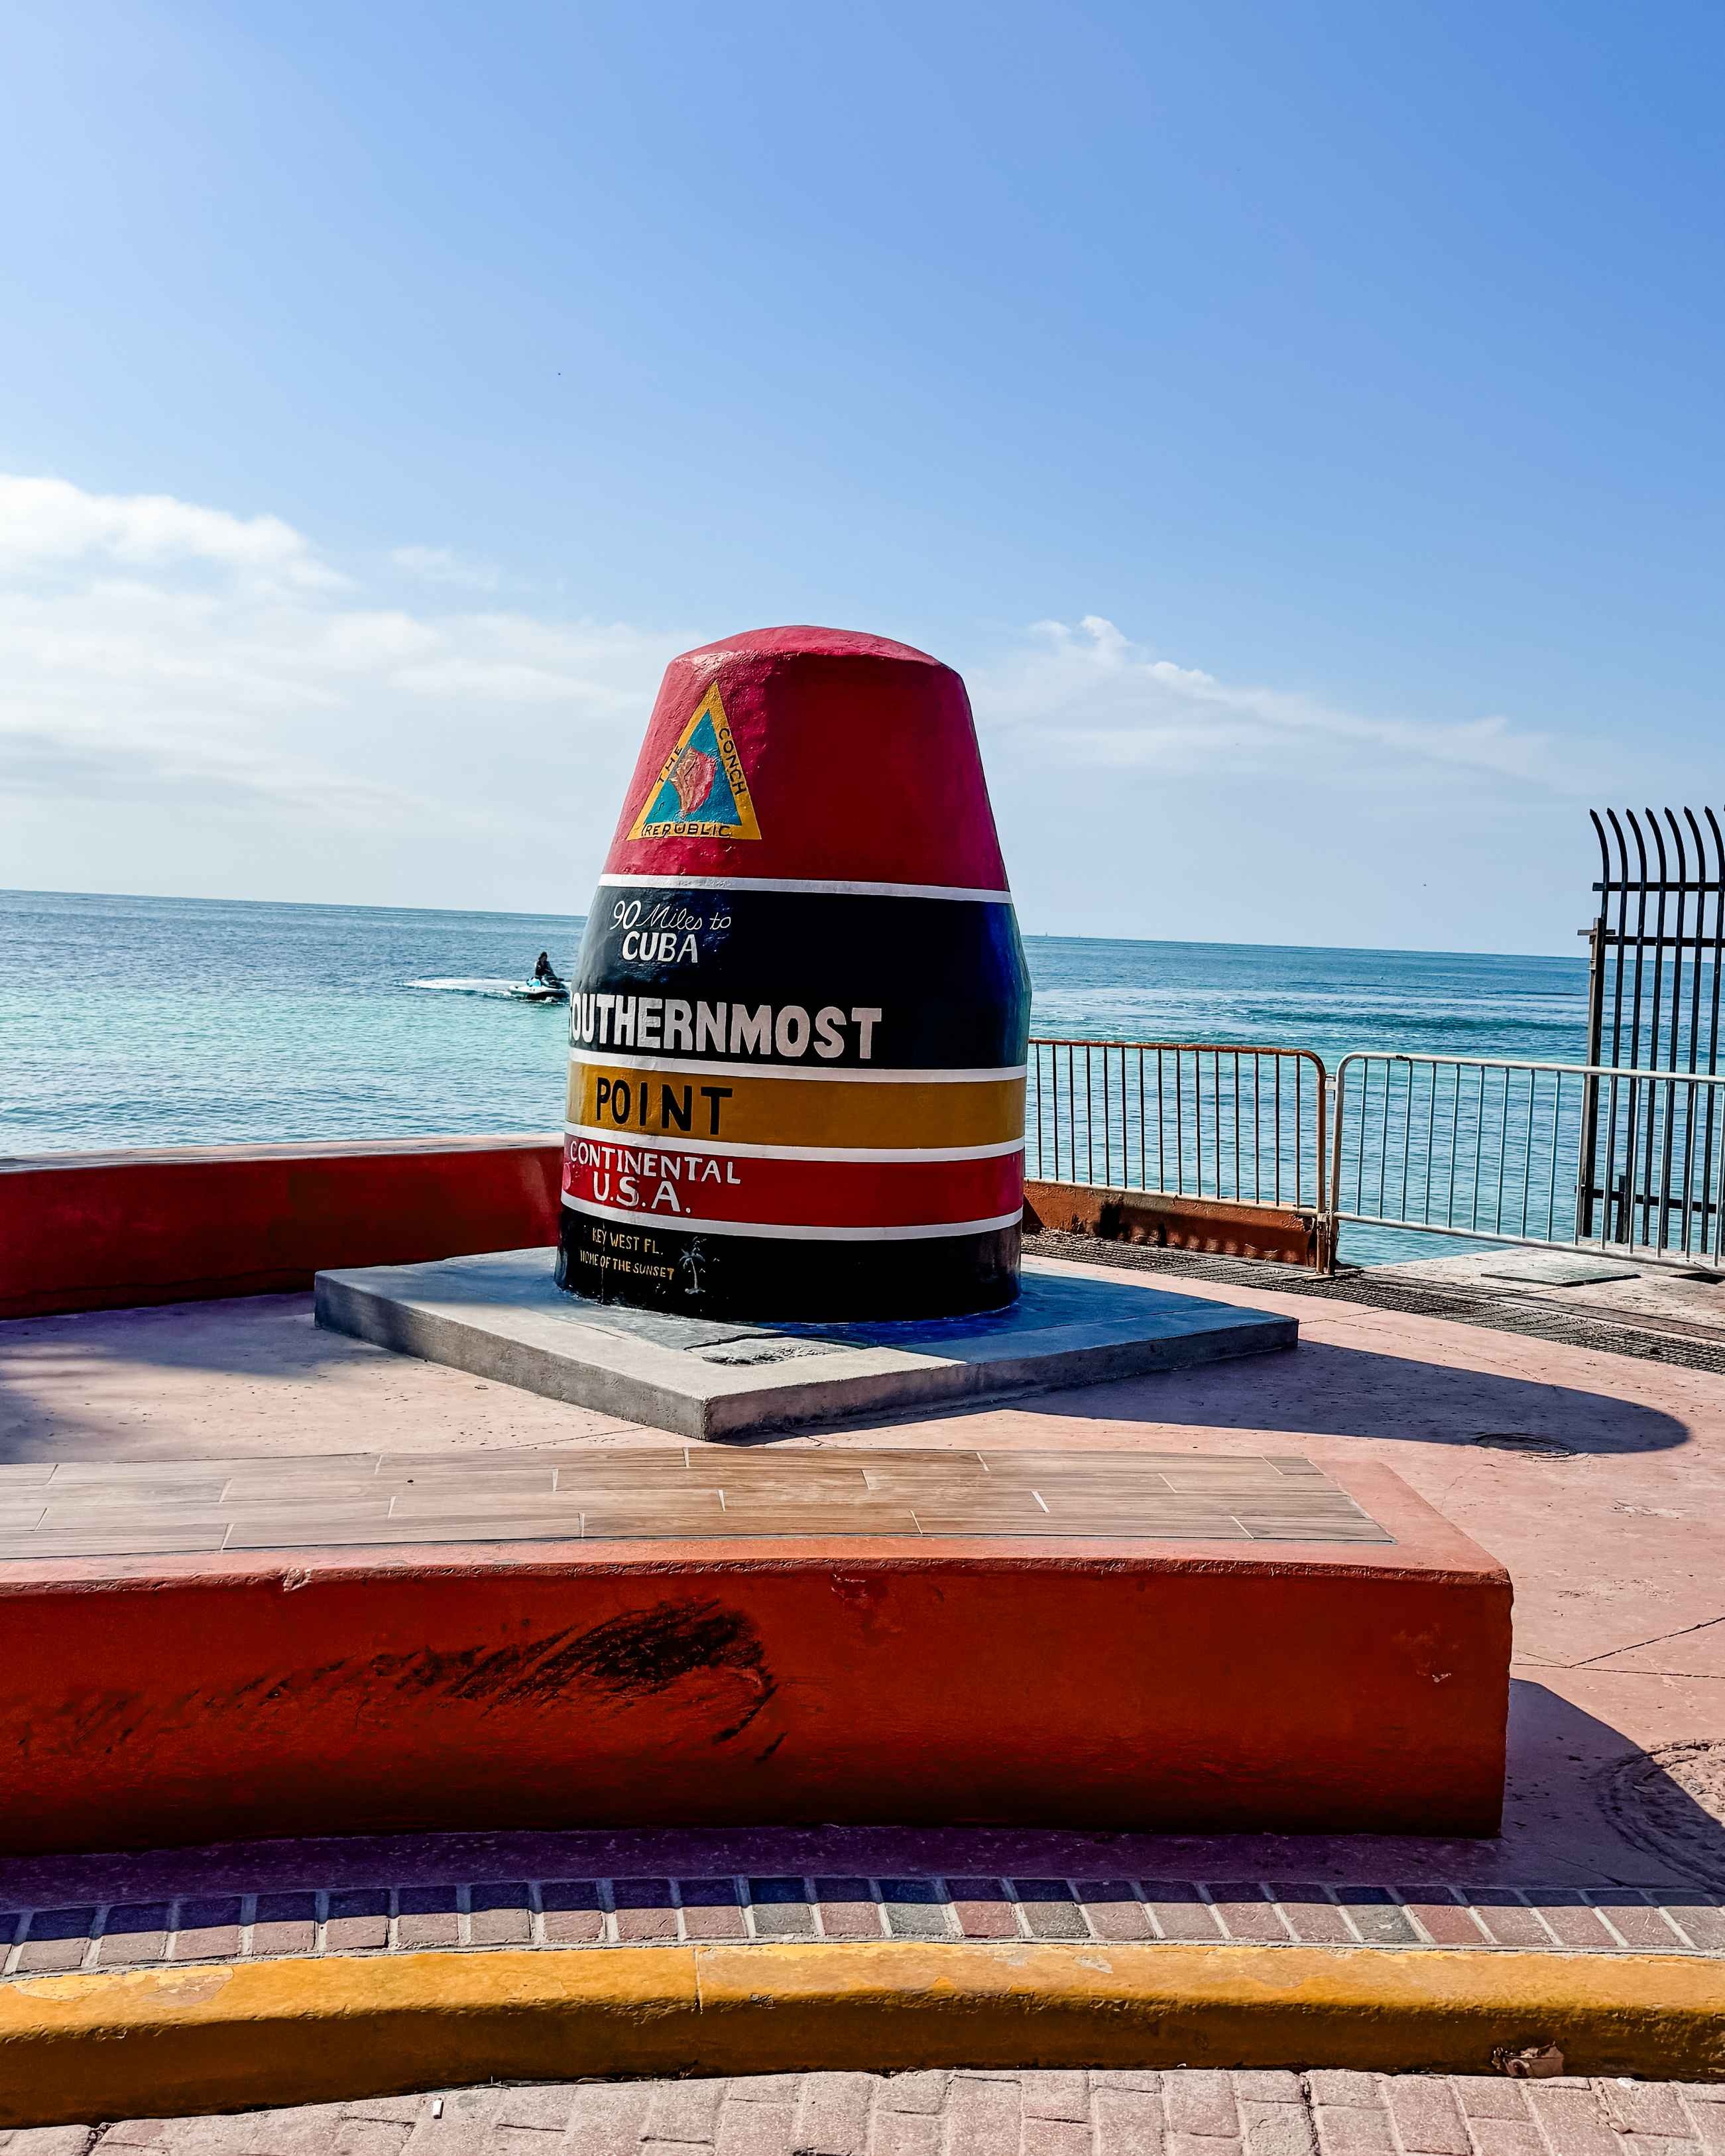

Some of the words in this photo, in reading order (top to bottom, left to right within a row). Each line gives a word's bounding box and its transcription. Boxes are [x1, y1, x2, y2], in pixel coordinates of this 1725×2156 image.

[657, 745, 684, 784] THE
[719, 727, 746, 795] CONCH
[642, 823, 733, 837] REPUBLIC
[609, 900, 642, 929] 90
[636, 903, 703, 930] Miles
[709, 912, 731, 930] to
[622, 931, 698, 963] CUBA
[569, 992, 882, 1059] OUTHERNMOST
[597, 1076, 733, 1136] POINT
[570, 1140, 741, 1184] CONTINENTAL
[593, 1171, 691, 1213] U.S.A.
[593, 1227, 607, 1245] KEY
[610, 1232, 640, 1251] WEST
[644, 1238, 664, 1255] FL.
[579, 1250, 599, 1266] HOME
[600, 1255, 611, 1269] OF
[613, 1258, 631, 1272] THE
[632, 1262, 675, 1281] SUNSET
